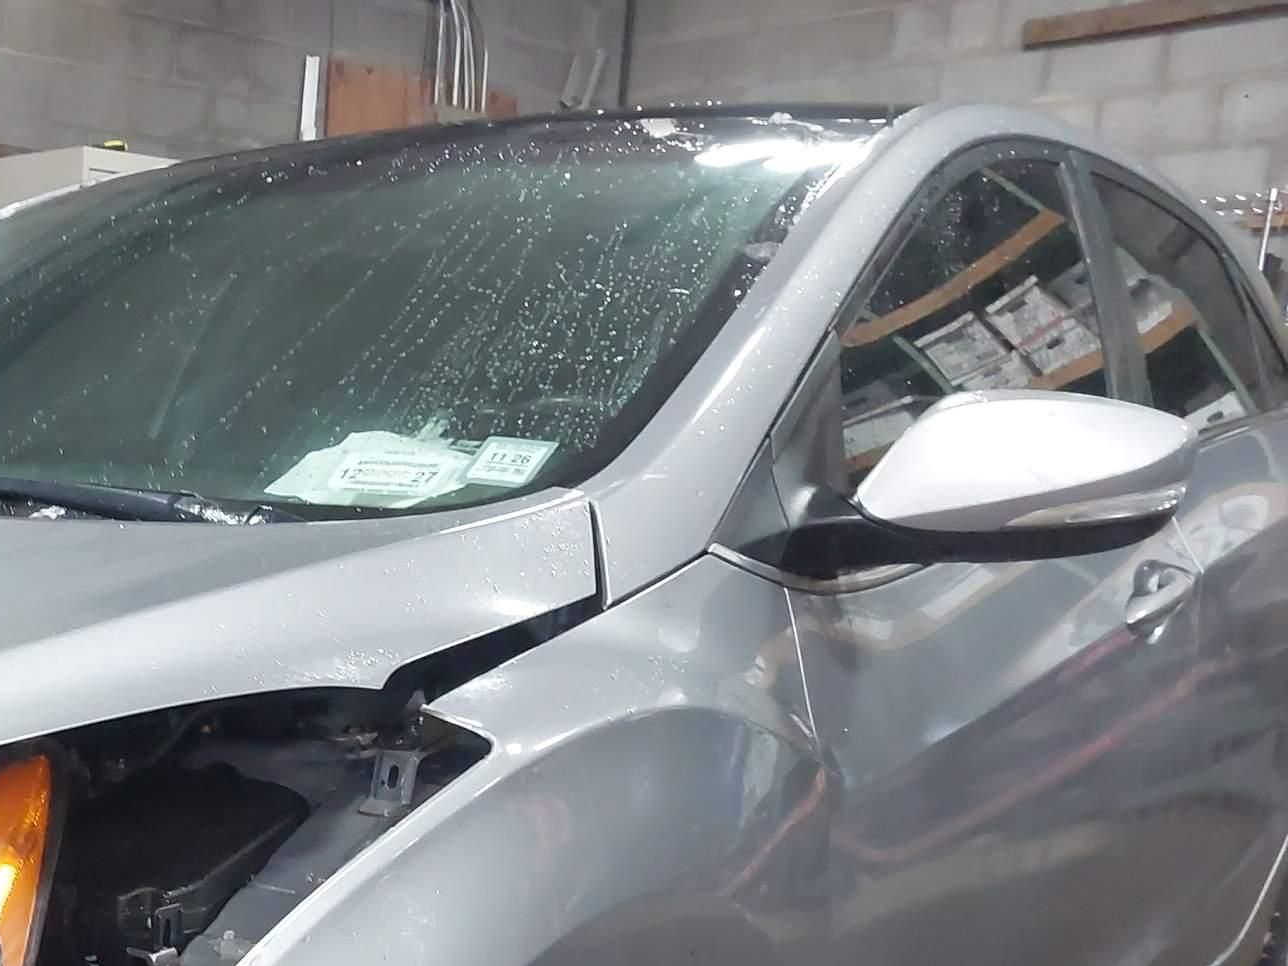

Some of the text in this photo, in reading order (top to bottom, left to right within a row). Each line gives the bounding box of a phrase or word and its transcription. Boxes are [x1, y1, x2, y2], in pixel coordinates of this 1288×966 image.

[512, 453, 532, 464] 26
[340, 468, 362, 479] 12
[410, 471, 439, 484] 27
